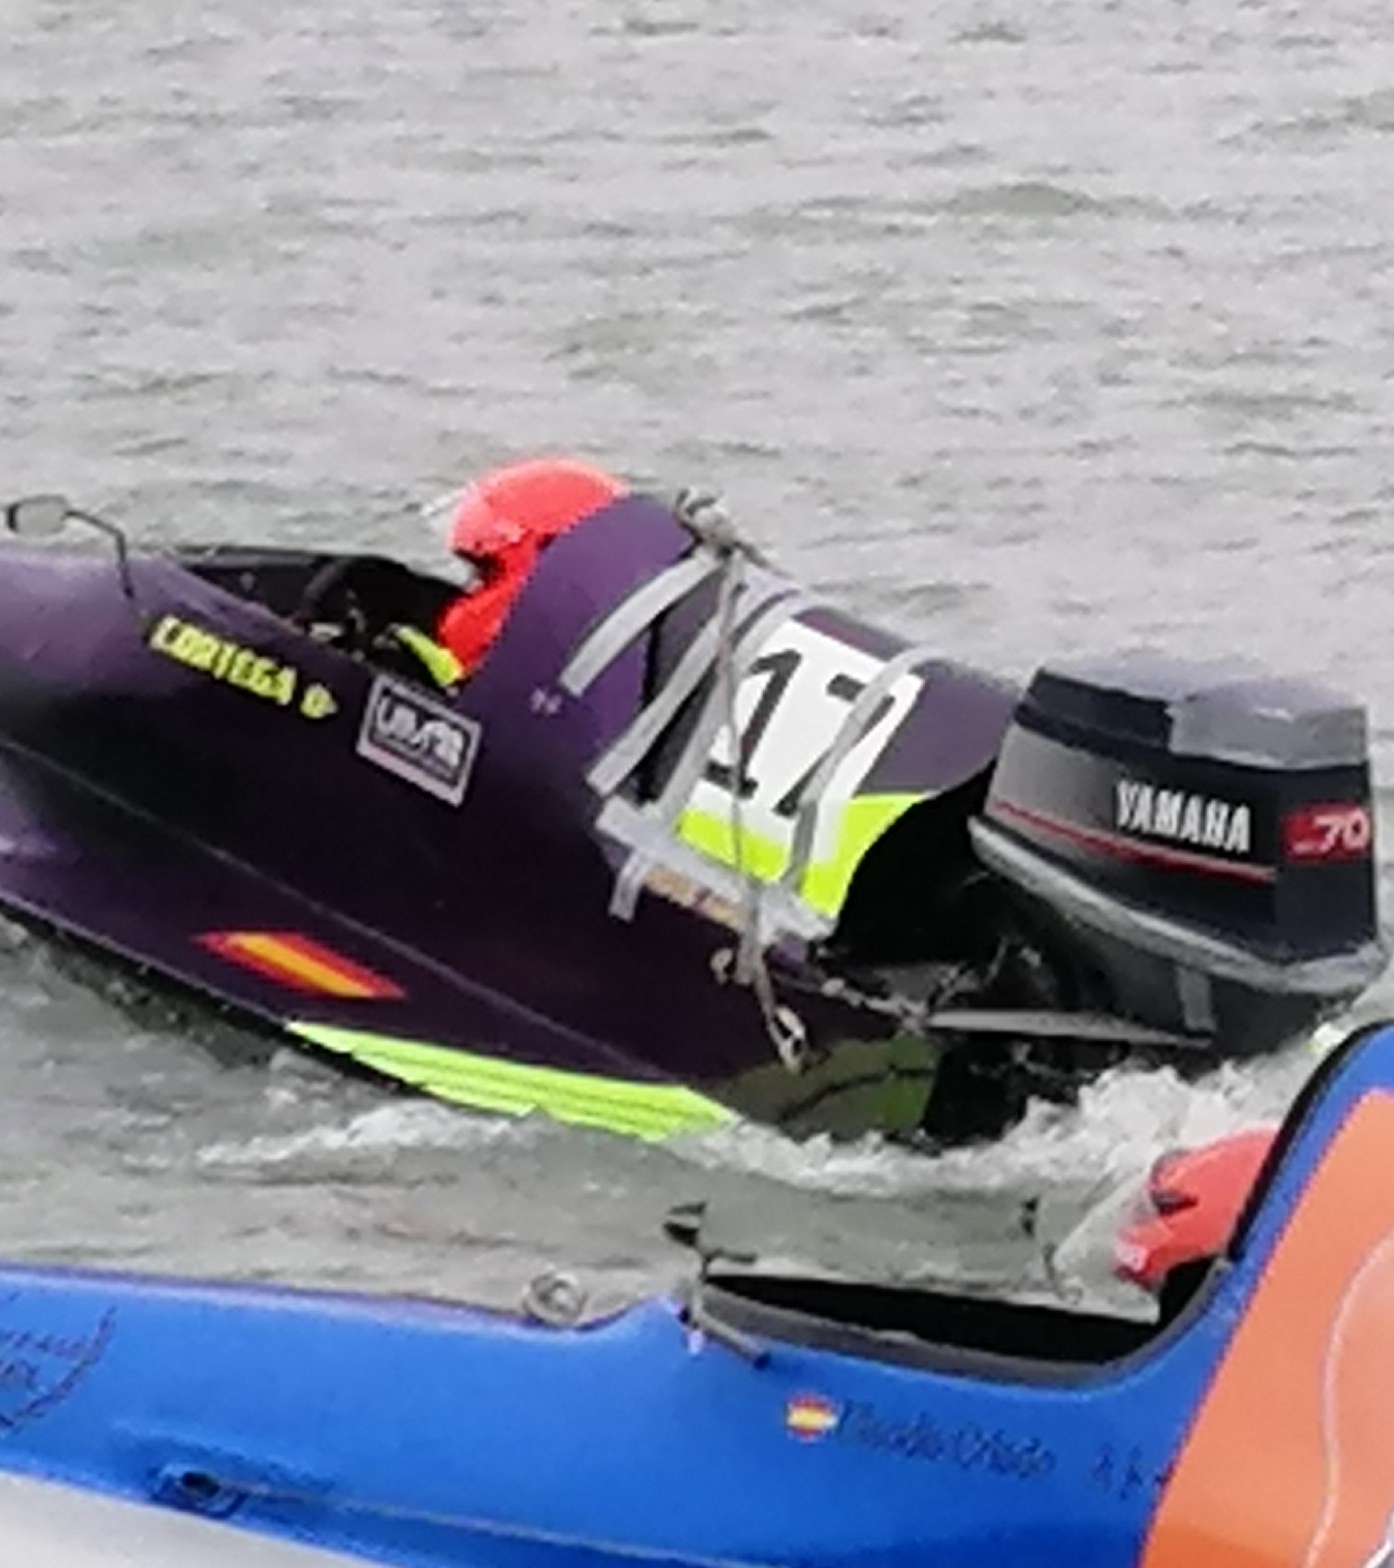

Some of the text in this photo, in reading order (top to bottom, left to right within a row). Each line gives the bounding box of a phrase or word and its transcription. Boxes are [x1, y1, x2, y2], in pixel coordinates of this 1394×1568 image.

[702, 649, 896, 820] 17
[1117, 780, 1370, 858] YAMAHA 70
